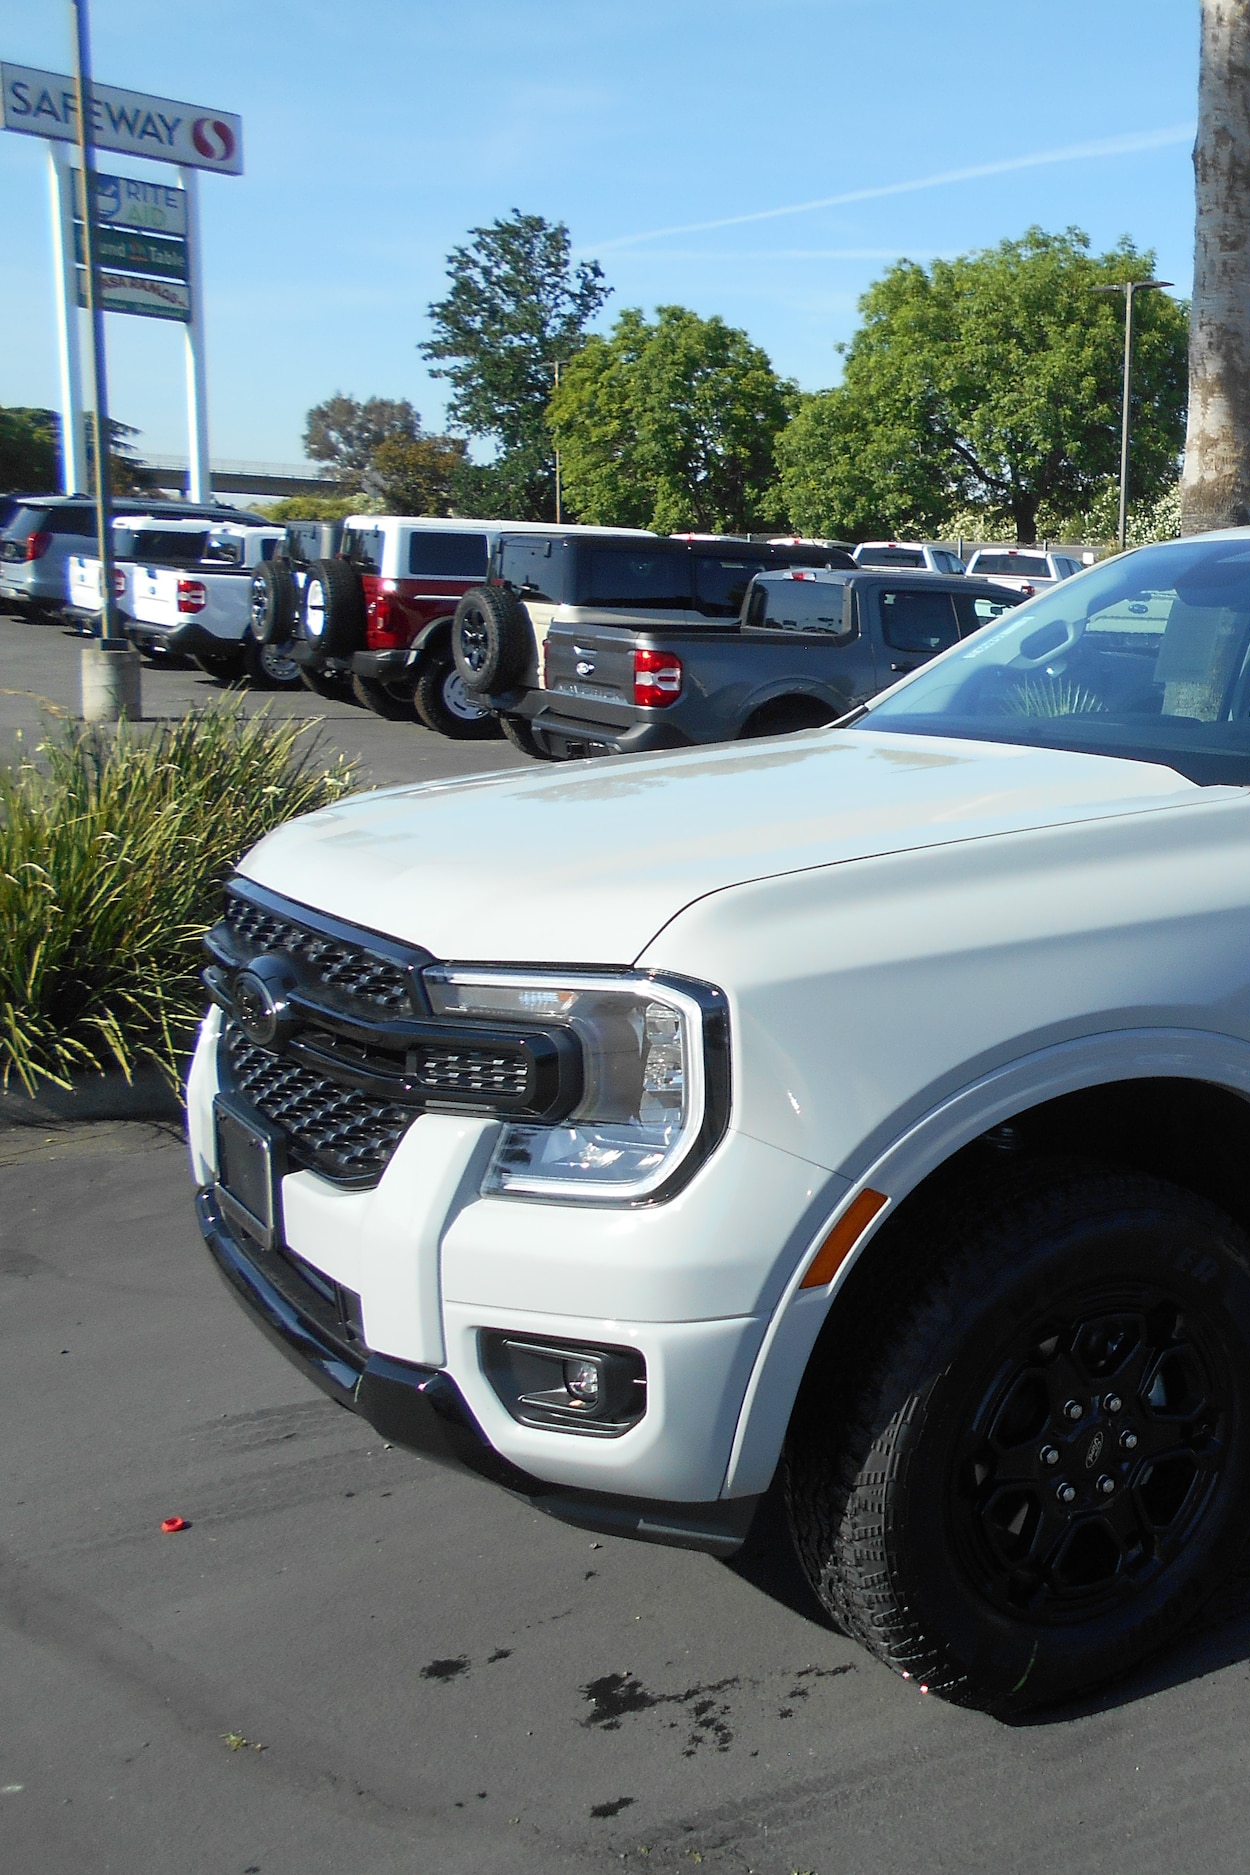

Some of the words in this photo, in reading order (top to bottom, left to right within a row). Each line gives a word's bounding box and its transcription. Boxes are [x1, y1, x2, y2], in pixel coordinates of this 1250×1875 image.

[11, 81, 182, 147] SAFEWAY
[126, 180, 178, 209] RITE
[127, 204, 167, 227] AID
